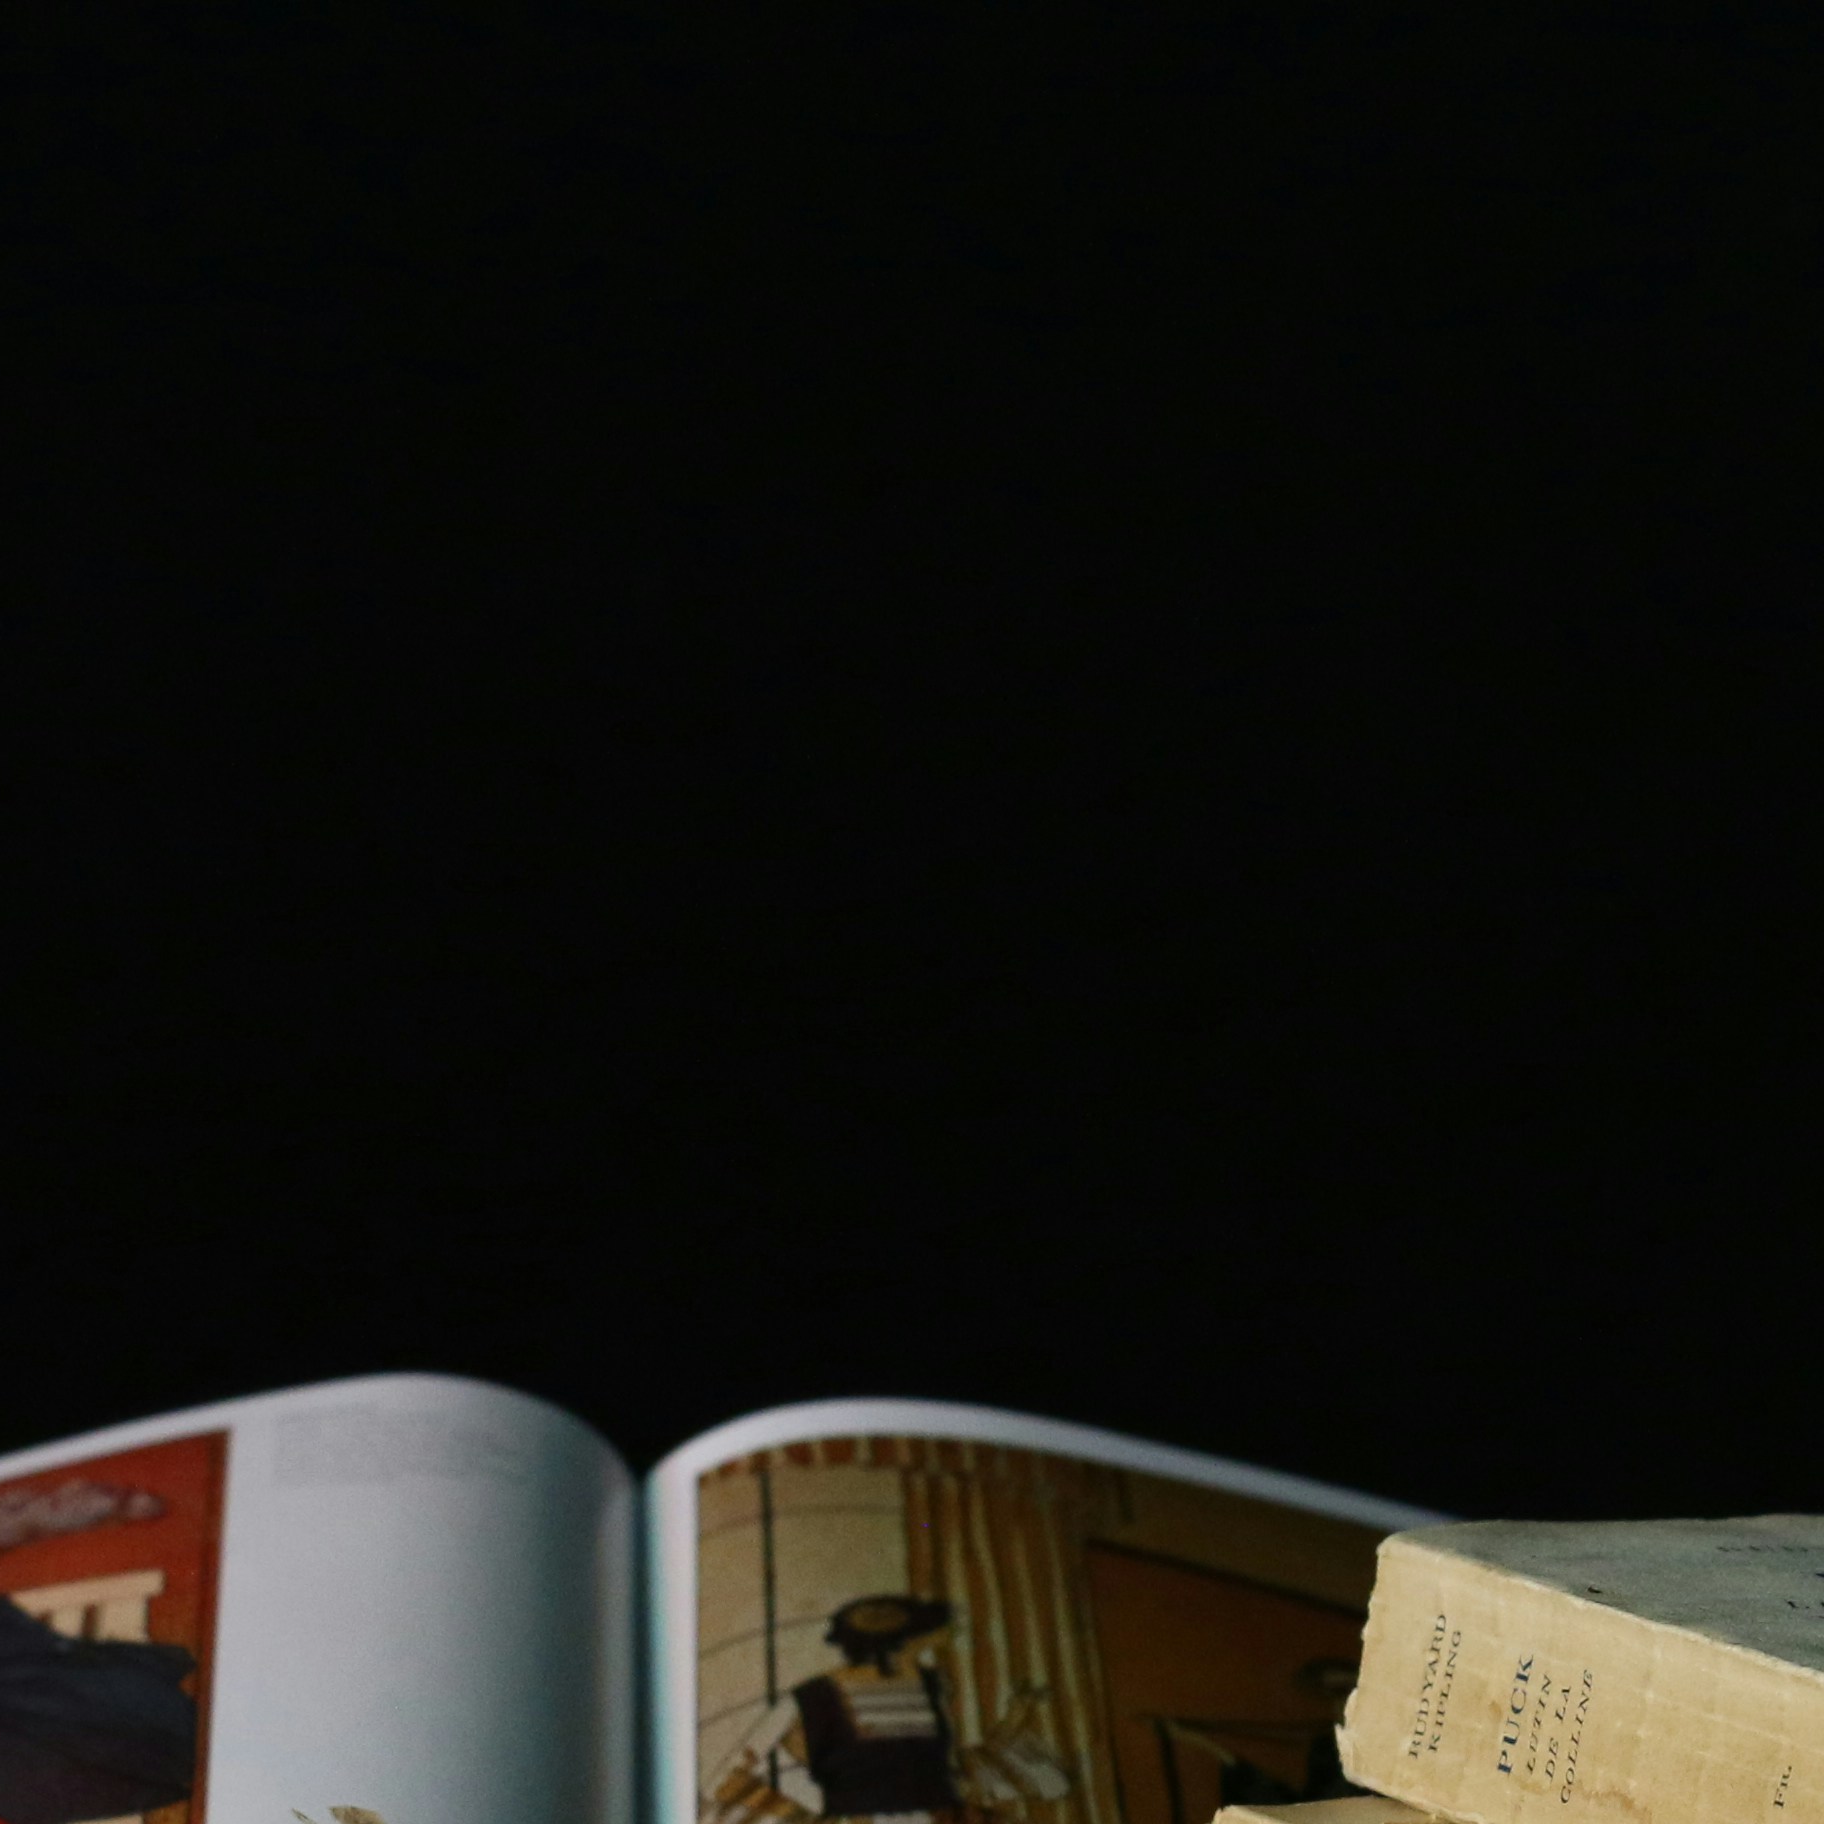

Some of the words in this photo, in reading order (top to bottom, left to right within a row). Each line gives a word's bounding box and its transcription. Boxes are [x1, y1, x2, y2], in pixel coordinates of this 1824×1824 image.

[1408, 1614, 1447, 1759] RUDYARD
[1428, 1630, 1462, 1753] KIPLING
[1497, 1654, 1534, 1776] PUCK
[1527, 1674, 1553, 1775] LUTIN
[1544, 1737, 1559, 1784] DE
[1554, 1686, 1572, 1724] LA
[1560, 1669, 1593, 1804] COLLINE
